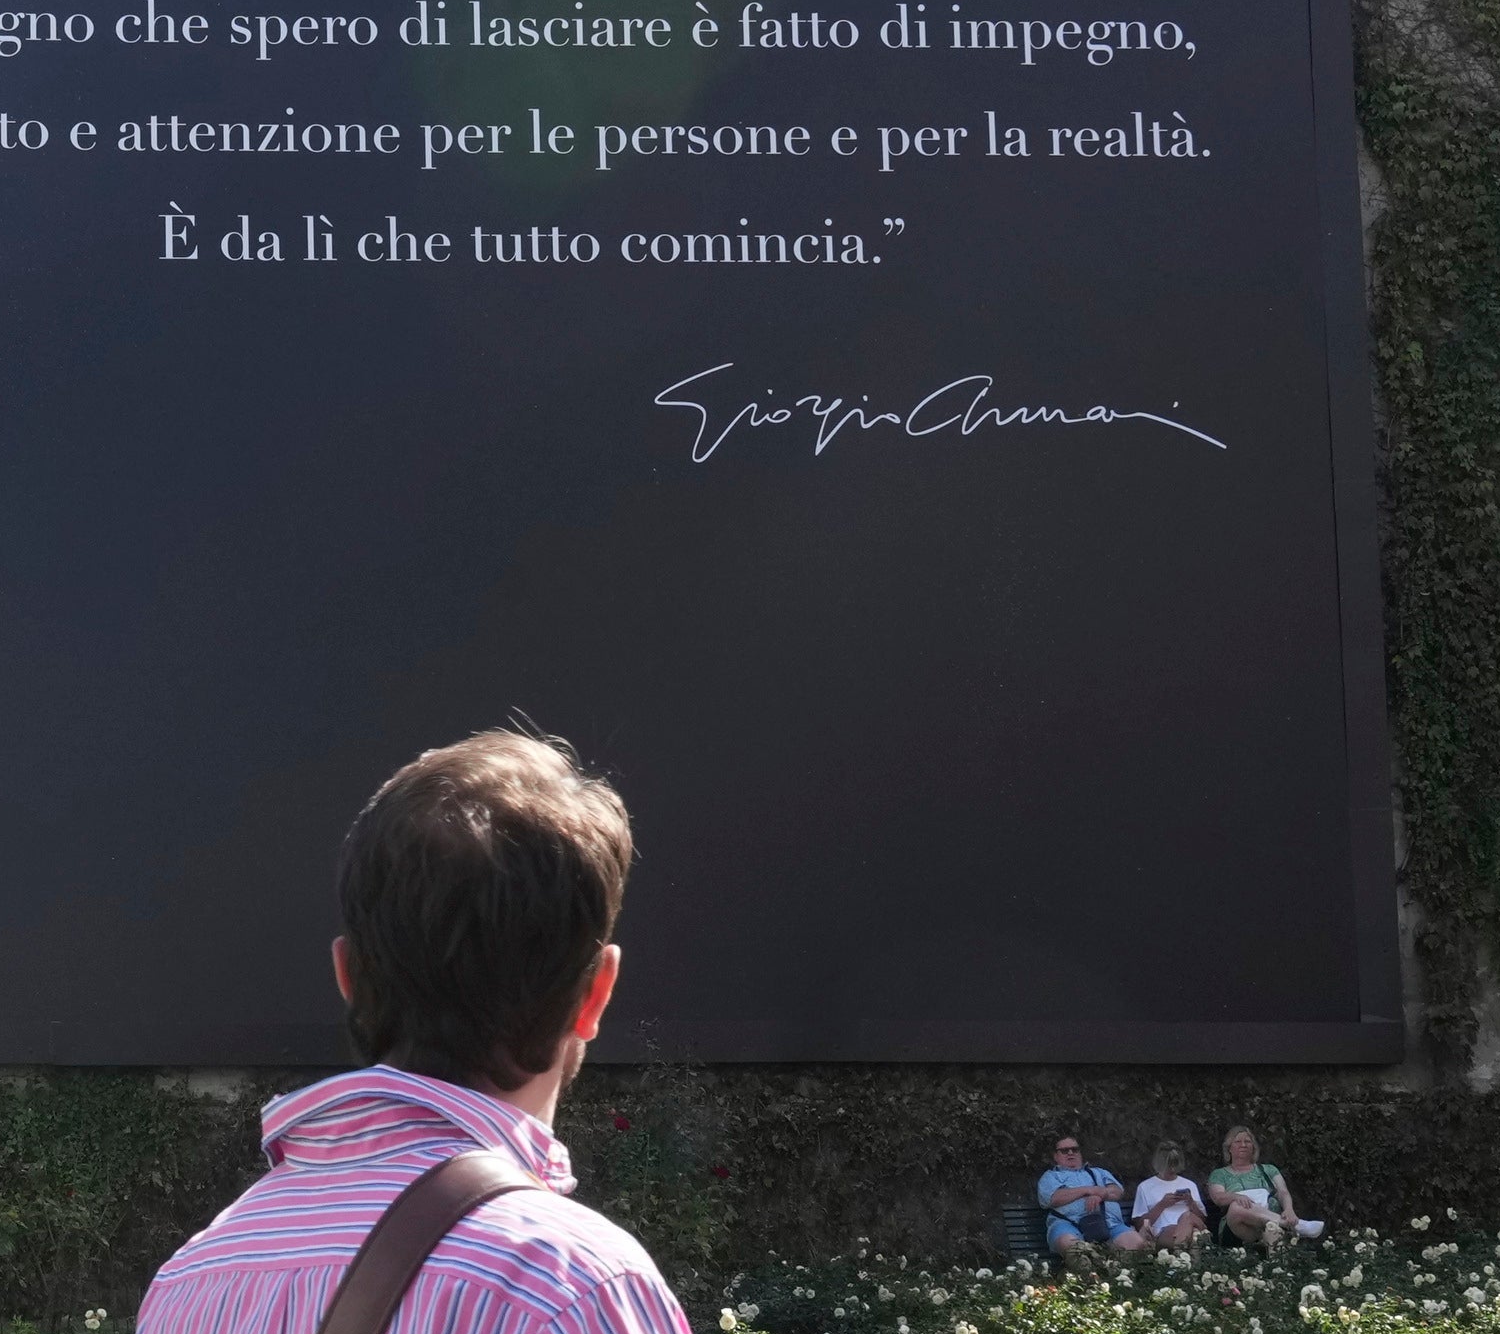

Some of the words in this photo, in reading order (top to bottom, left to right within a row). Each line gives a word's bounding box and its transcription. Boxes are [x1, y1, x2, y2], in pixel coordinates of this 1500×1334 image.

[230, 15, 379, 61] spero
[399, 0, 451, 46] di
[468, 0, 672, 48] lasciare
[691, 0, 719, 48] è
[738, 1, 860, 49] fatto
[879, 3, 932, 49] di
[948, 3, 1197, 67] impegno,
[69, 121, 98, 151] e
[117, 106, 401, 154] attenzione
[419, 124, 512, 170] per
[527, 108, 575, 155] le
[593, 125, 811, 171] persone
[830, 126, 858, 156] e
[876, 126, 968, 172] per
[983, 110, 1032, 157] la
[1047, 110, 1211, 158] realtà.
[158, 200, 199, 260] È
[220, 214, 286, 262] da
[301, 214, 338, 261] lì
[357, 215, 451, 263] che
[469, 225, 601, 263] tutto
[620, 217, 906, 265] comincia.”
